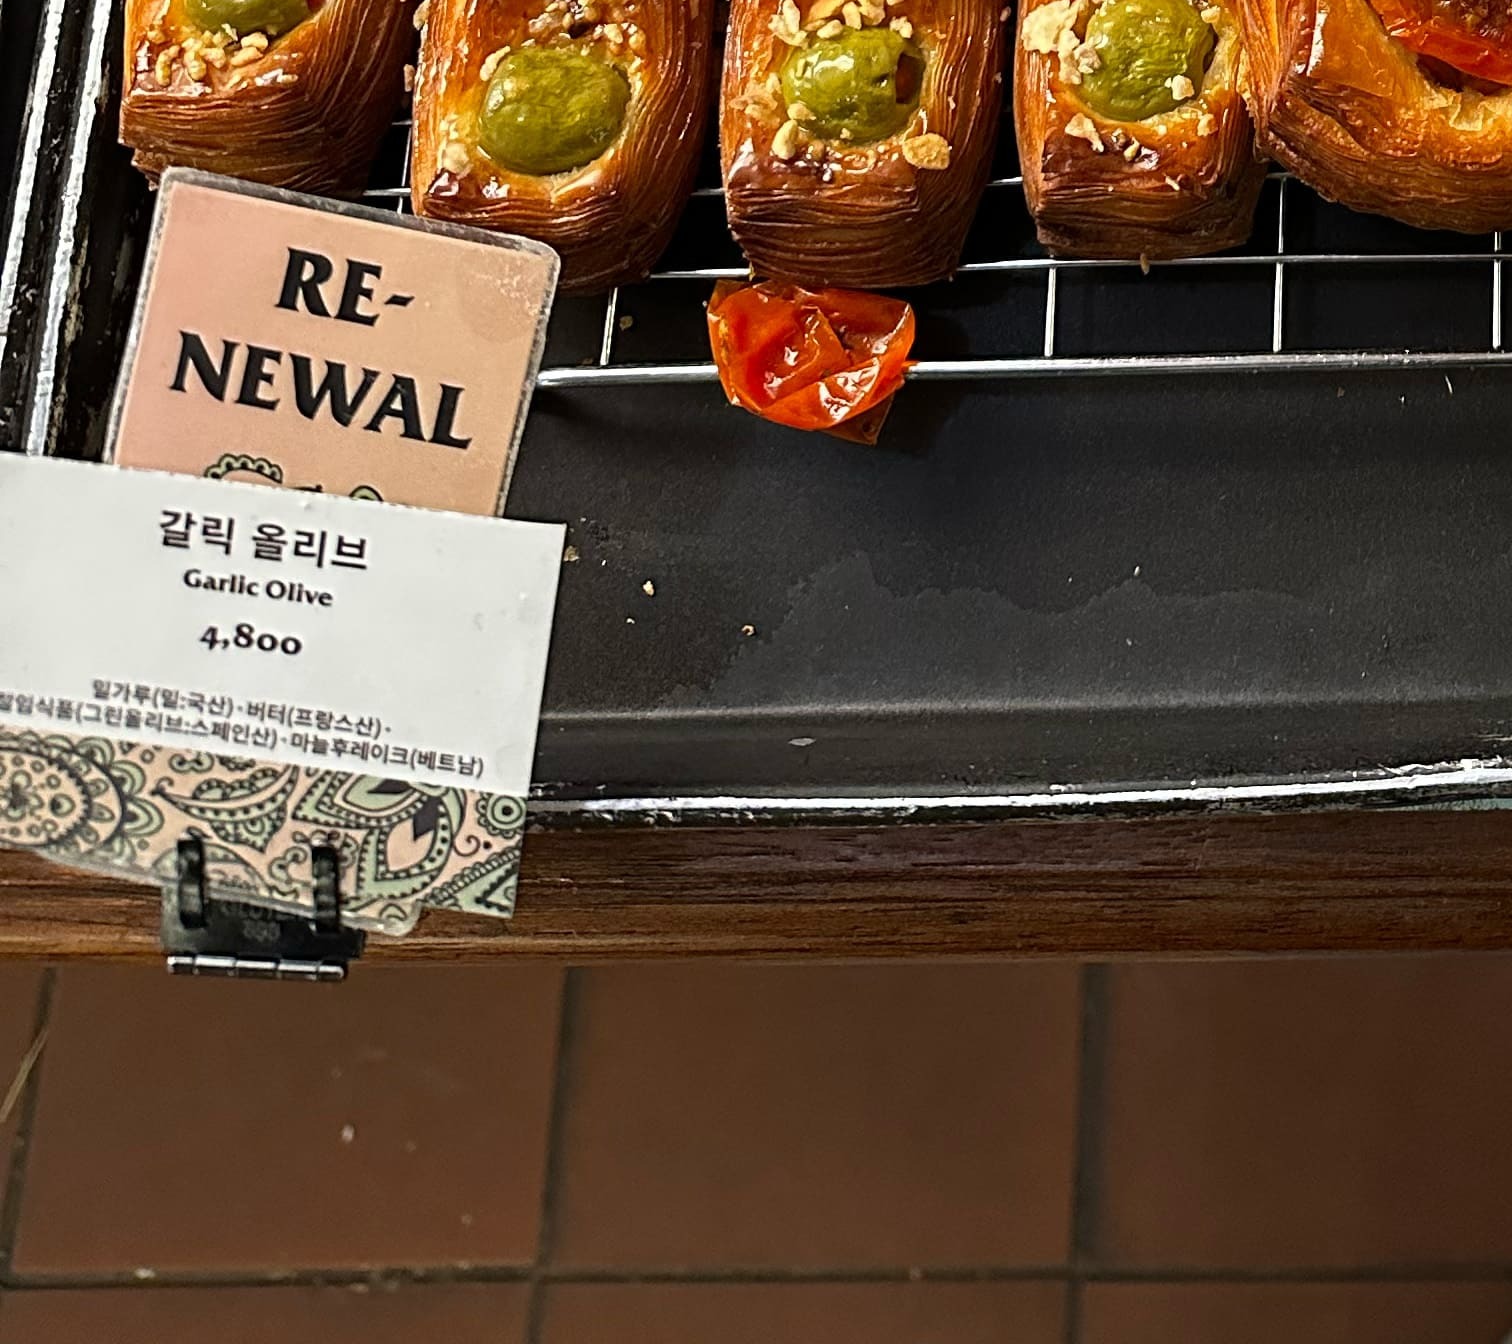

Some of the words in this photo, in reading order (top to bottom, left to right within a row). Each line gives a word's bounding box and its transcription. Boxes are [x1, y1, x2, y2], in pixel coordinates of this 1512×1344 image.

[274, 247, 415, 326] RE-
[169, 329, 473, 449] NEWAL
[159, 510, 235, 556] 갈릭
[251, 522, 368, 570] 올리브
[183, 568, 259, 597] Garlic
[265, 580, 333, 607] Olive
[200, 622, 303, 656] 4,800
